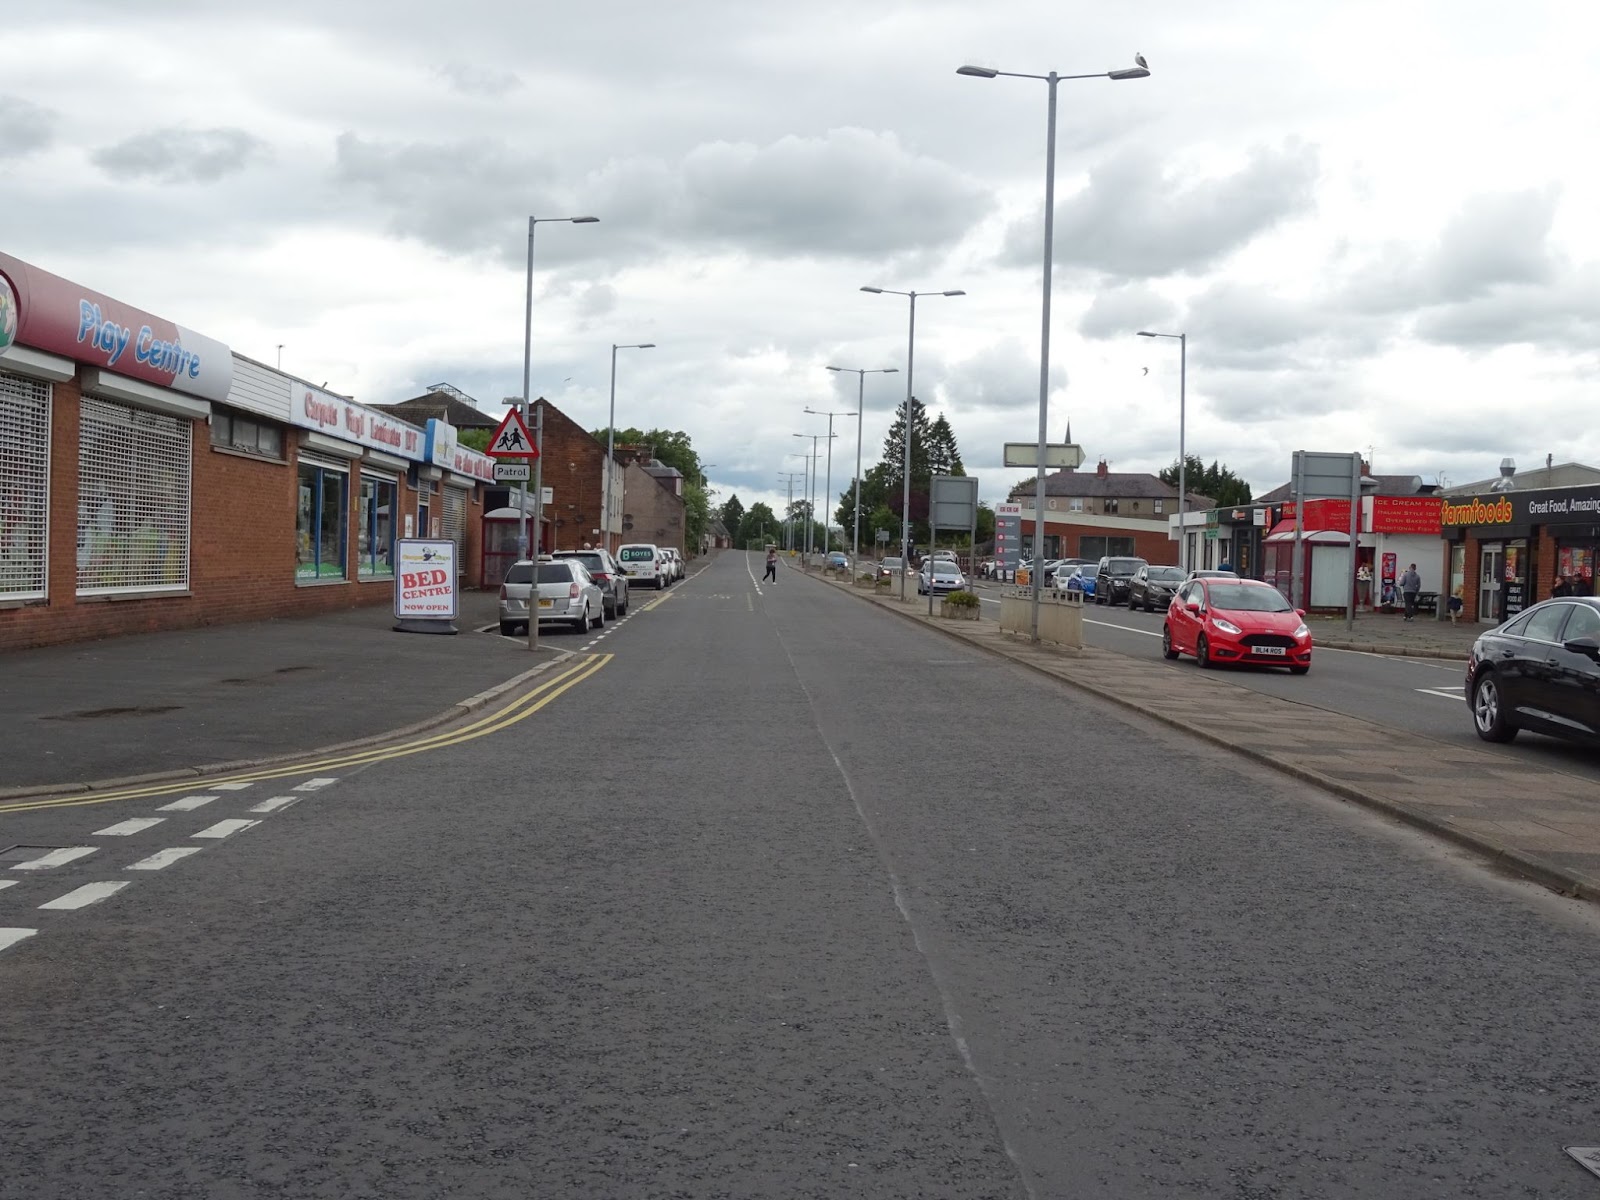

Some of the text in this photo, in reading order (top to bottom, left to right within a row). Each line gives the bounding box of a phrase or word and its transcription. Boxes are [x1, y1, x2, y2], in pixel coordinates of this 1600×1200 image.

[77, 299, 200, 380] Play Centre
[305, 392, 338, 428] Carpets
[345, 406, 364, 439] Vinyl
[498, 467, 526, 476] Patrol
[1441, 496, 1512, 526] farmfoods
[1529, 501, 1548, 514] Great
[1549, 499, 1568, 514] Food,
[622, 550, 629, 560] B
[402, 569, 447, 589] BED
[402, 586, 452, 599] CENTRE
